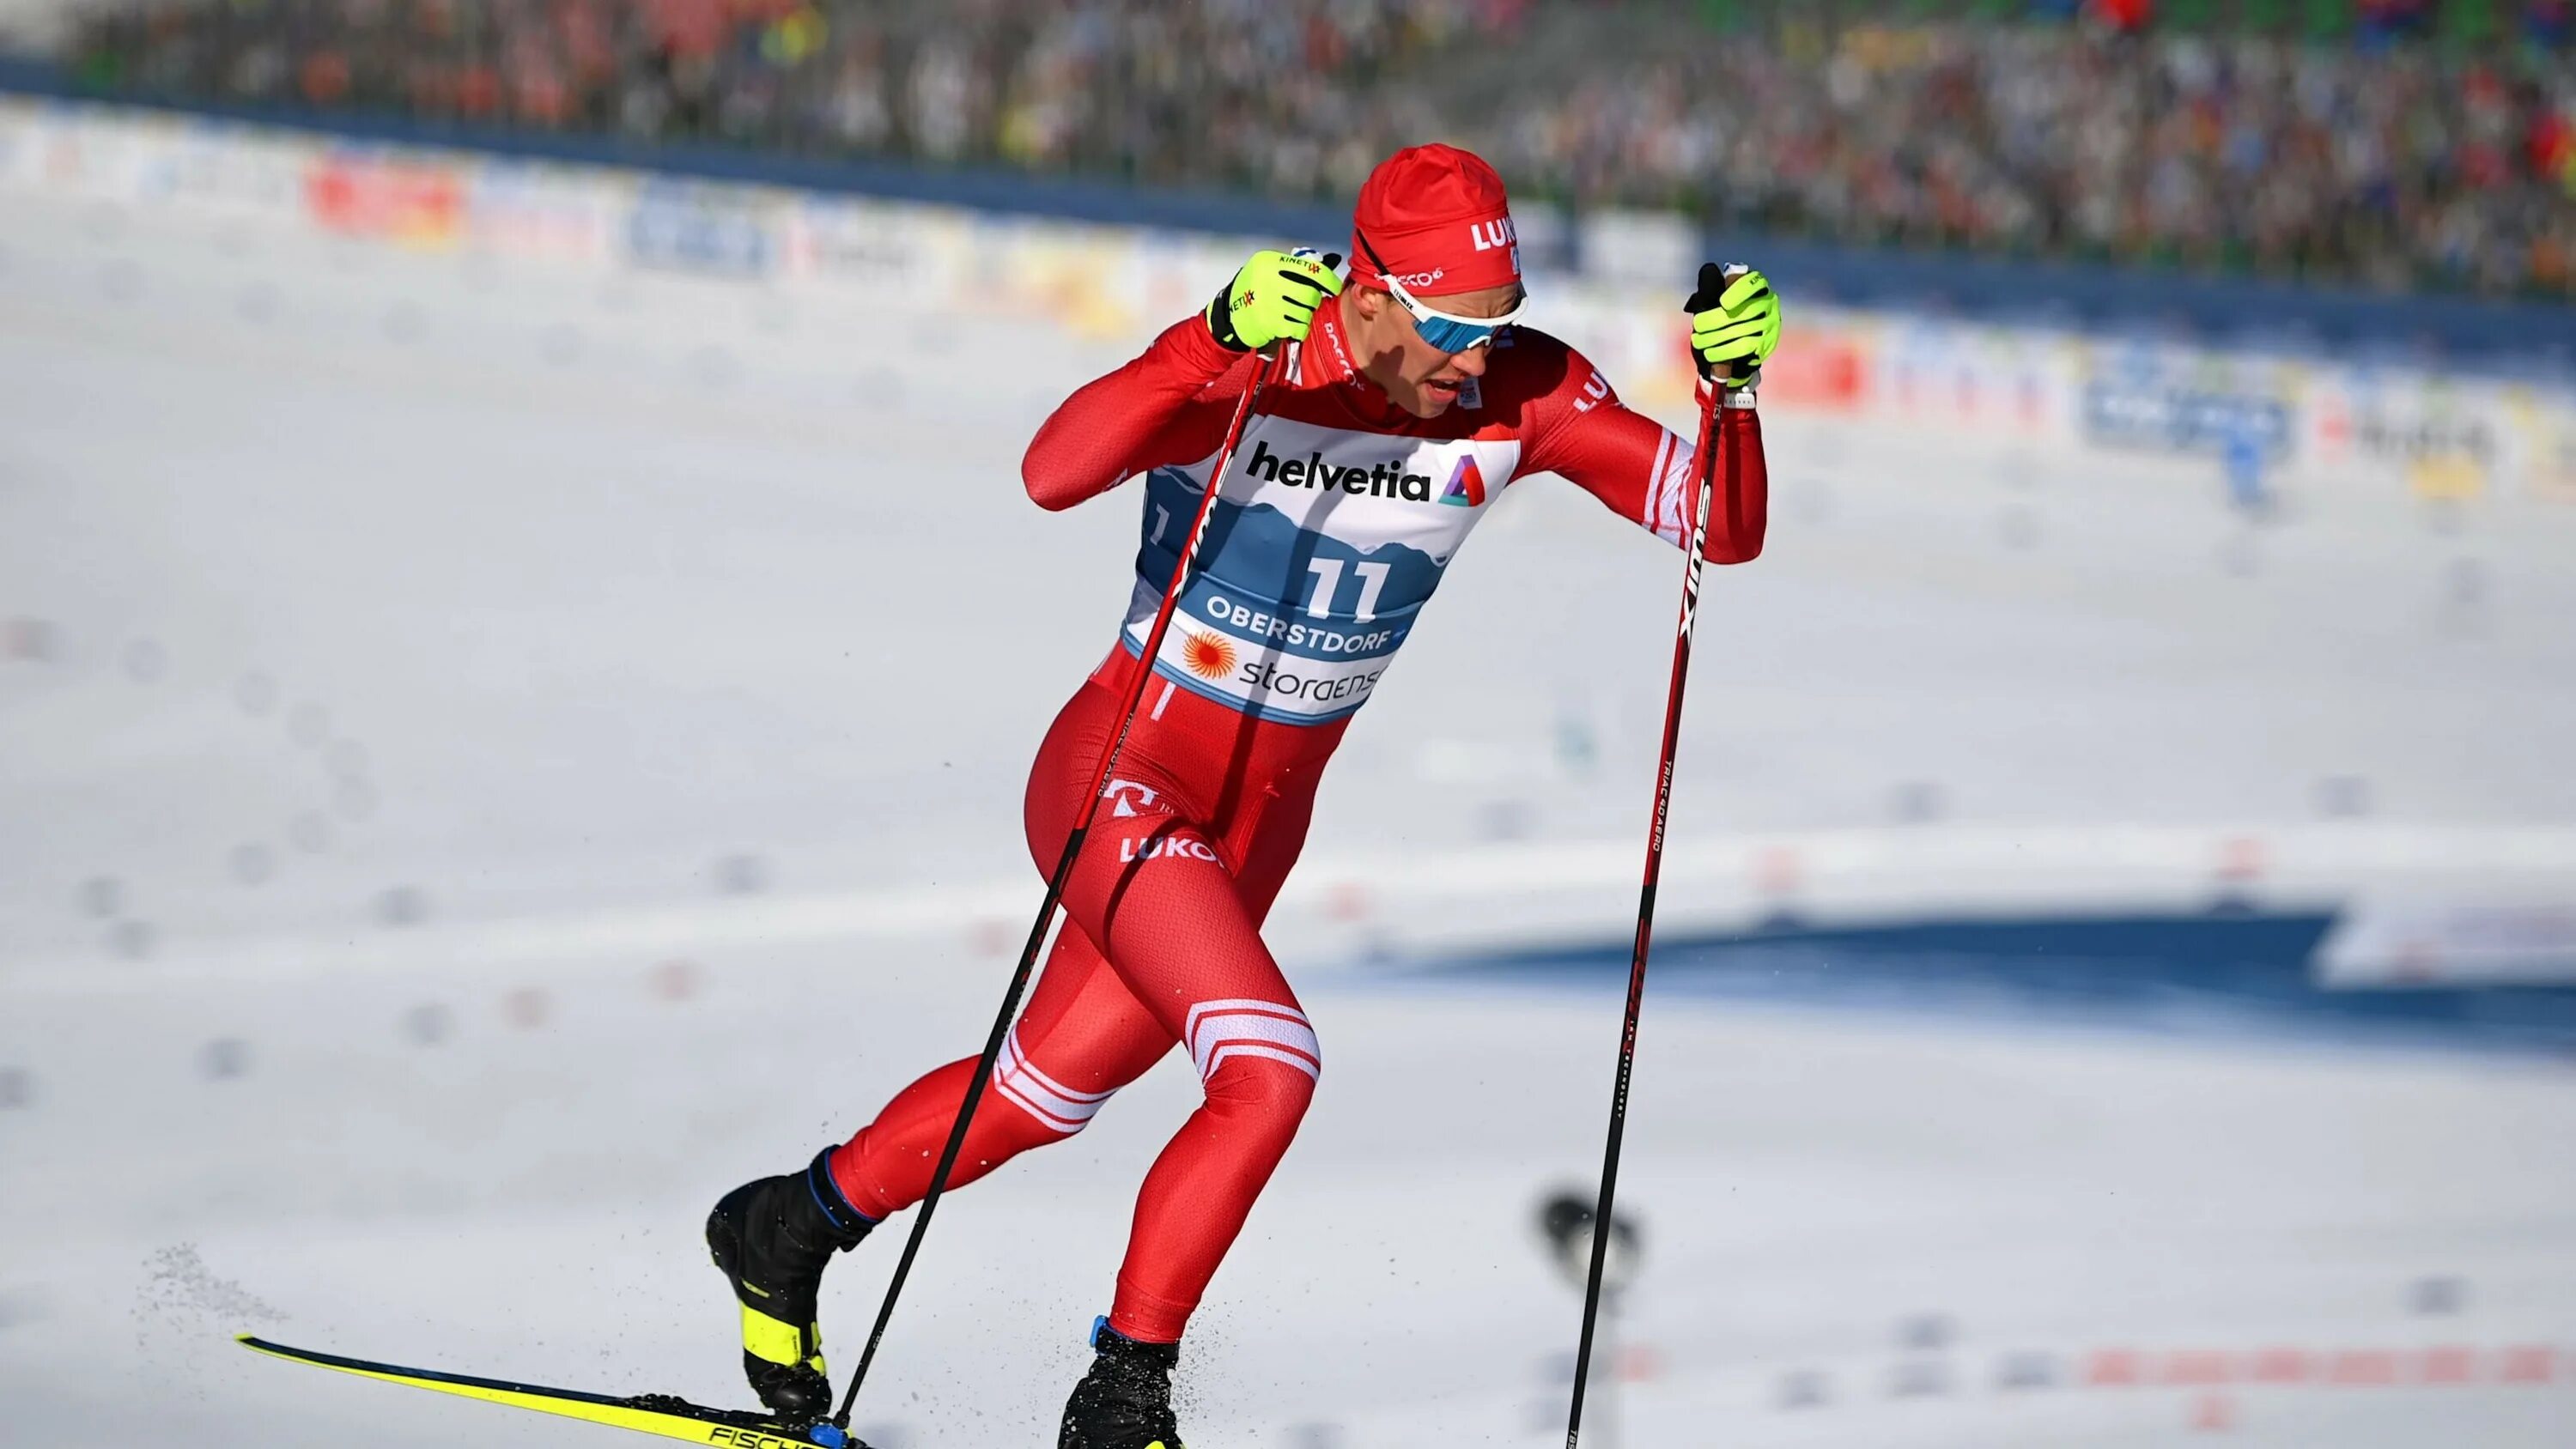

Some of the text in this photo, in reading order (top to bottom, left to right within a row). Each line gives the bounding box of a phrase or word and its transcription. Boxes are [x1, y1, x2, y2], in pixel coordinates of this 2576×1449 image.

[1246, 440, 1431, 502] helvetia
[1307, 557, 1391, 624] 11
[1680, 477, 1711, 650] SWIX
[1206, 596, 1391, 653] OBERSTDORF
[1660, 761, 1672, 797] TRIAC
[1653, 816, 1664, 852] AERO
